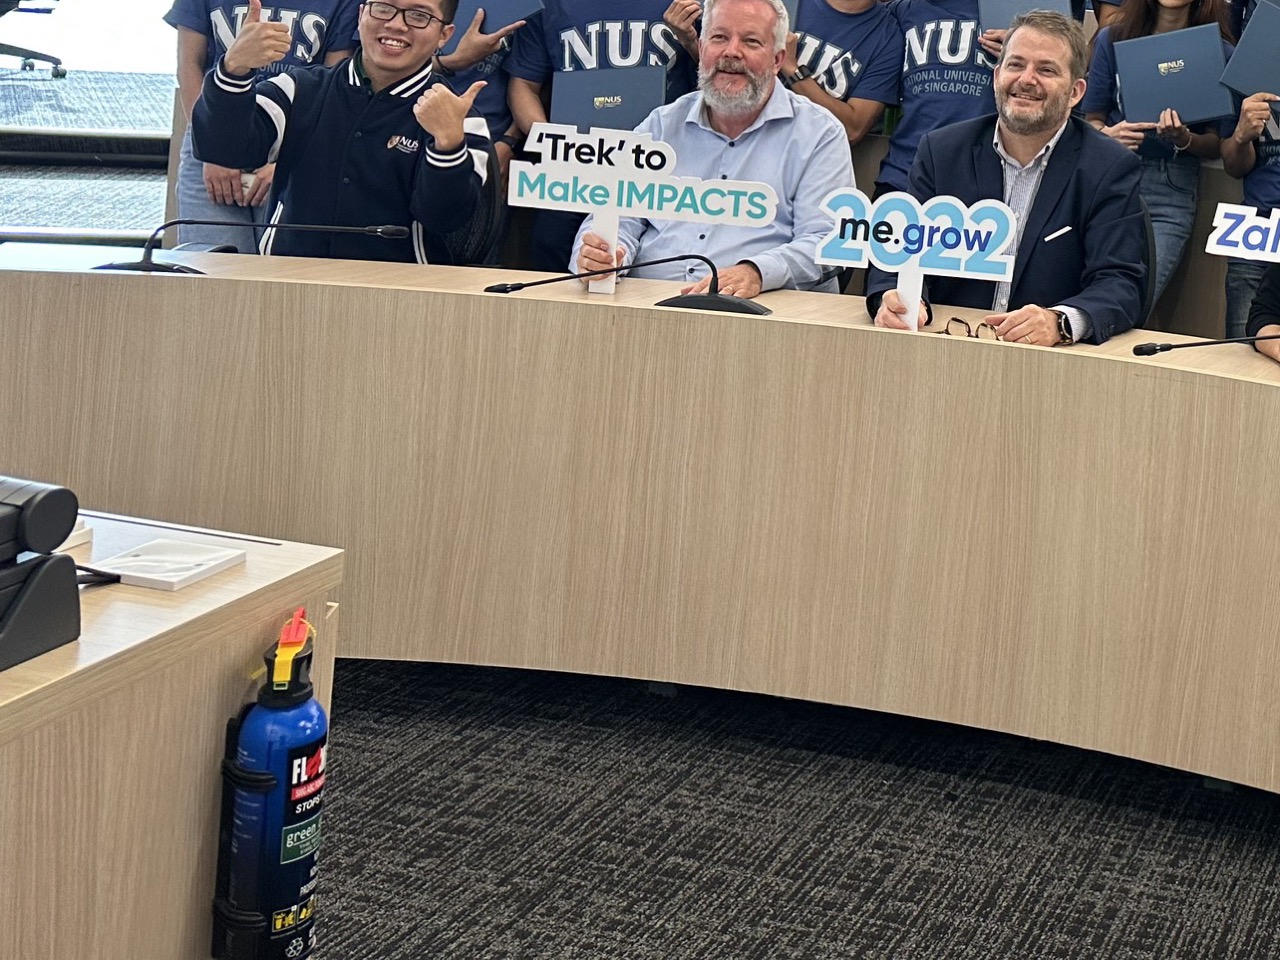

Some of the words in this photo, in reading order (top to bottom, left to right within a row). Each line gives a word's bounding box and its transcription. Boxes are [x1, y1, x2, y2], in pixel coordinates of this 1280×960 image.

[560, 20, 677, 71] NUS
[1168, 59, 1184, 69] NUS
[604, 95, 622, 104] NUS
[912, 84, 923, 95] OF
[924, 82, 983, 96] SINGAPORE
[400, 138, 419, 150] NUS
[632, 144, 667, 171] to
[516, 171, 610, 206] Make
[616, 179, 768, 220] IMPACTS
[821, 193, 1010, 275] 2022
[839, 217, 993, 255] me.grow
[286, 823, 317, 848] green
